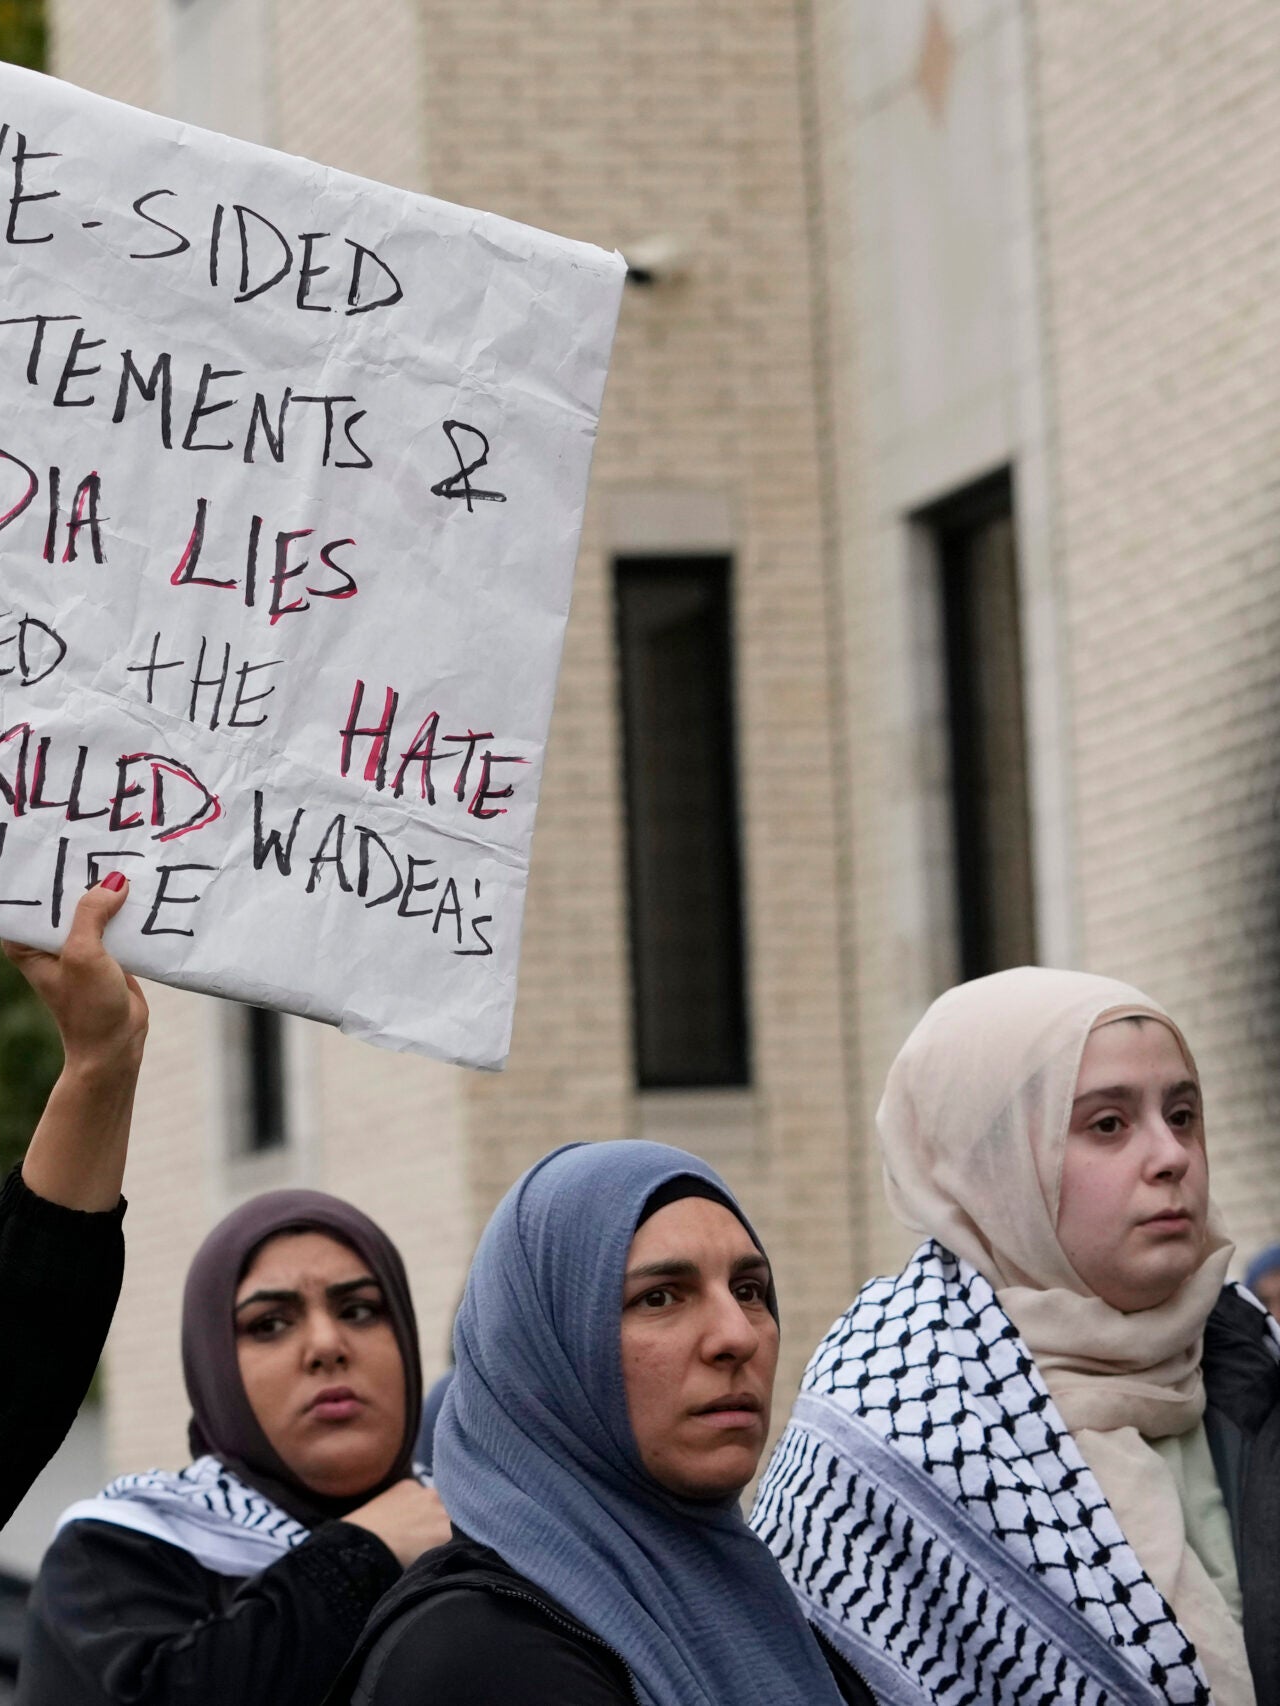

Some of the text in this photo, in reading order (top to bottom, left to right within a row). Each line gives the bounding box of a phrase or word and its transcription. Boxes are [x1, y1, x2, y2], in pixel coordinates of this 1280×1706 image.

[430, 419, 508, 514] &
[169, 496, 360, 626] LIES
[338, 679, 529, 820] HATE
[252, 789, 494, 956] WADEA'S
